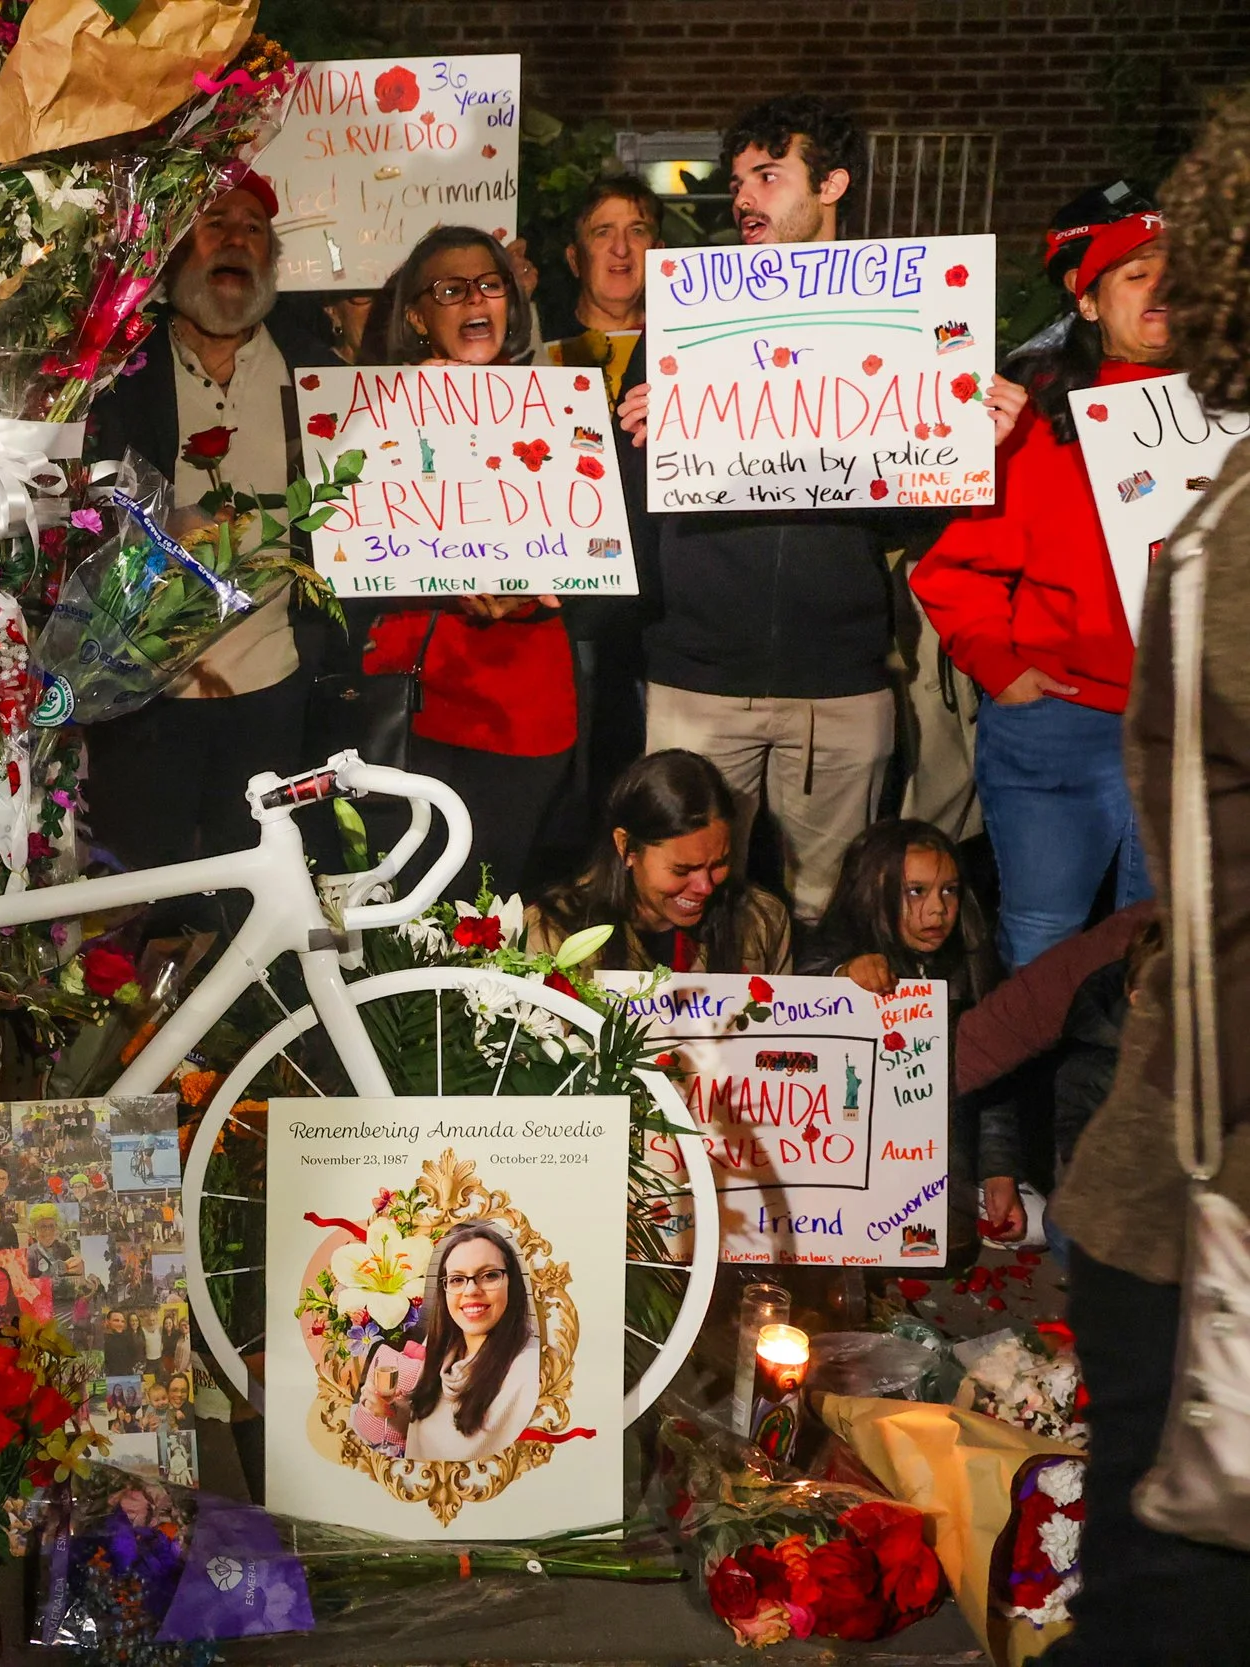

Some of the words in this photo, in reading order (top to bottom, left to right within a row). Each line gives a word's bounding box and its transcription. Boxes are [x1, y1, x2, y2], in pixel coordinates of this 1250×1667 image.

[428, 61, 467, 91] 36
[454, 88, 513, 116] years
[487, 106, 515, 128] old
[401, 169, 517, 208] criminals
[669, 243, 927, 306] JUSTICE
[340, 369, 556, 434] AMANDA
[656, 451, 716, 482] 5th
[727, 446, 808, 478] death
[820, 446, 858, 485] by
[870, 440, 959, 479] police
[890, 471, 951, 489] TIME
[963, 469, 992, 485] FOR
[322, 479, 603, 533] SERVEDIO
[663, 485, 736, 508] chase
[745, 483, 796, 503] this
[896, 485, 994, 507] CHANGE!!!
[364, 534, 410, 564] 36
[525, 532, 569, 559] old
[353, 575, 397, 592] LIFE
[414, 575, 477, 592] TAKEN
[491, 577, 530, 592] TOO
[552, 573, 623, 592] SOON!!!
[773, 994, 855, 1026] Cousin
[881, 1002, 934, 1031] BEING
[904, 1063, 926, 1080] in
[686, 1075, 832, 1128] AMANDA
[893, 1082, 934, 1108] law
[288, 1120, 420, 1143] Remembering
[426, 1121, 518, 1139] Amanda
[521, 1119, 606, 1139] Servedio
[300, 1154, 361, 1166] November
[363, 1154, 381, 1167] 23,
[383, 1154, 410, 1166] 1987
[489, 1153, 538, 1165] October
[540, 1153, 558, 1167] 22,
[560, 1152, 590, 1165] 2024
[880, 1138, 939, 1161] Aunt
[722, 1250, 771, 1263] fucking
[779, 1250, 835, 1265] fabulous
[841, 1254, 883, 1267] person!
